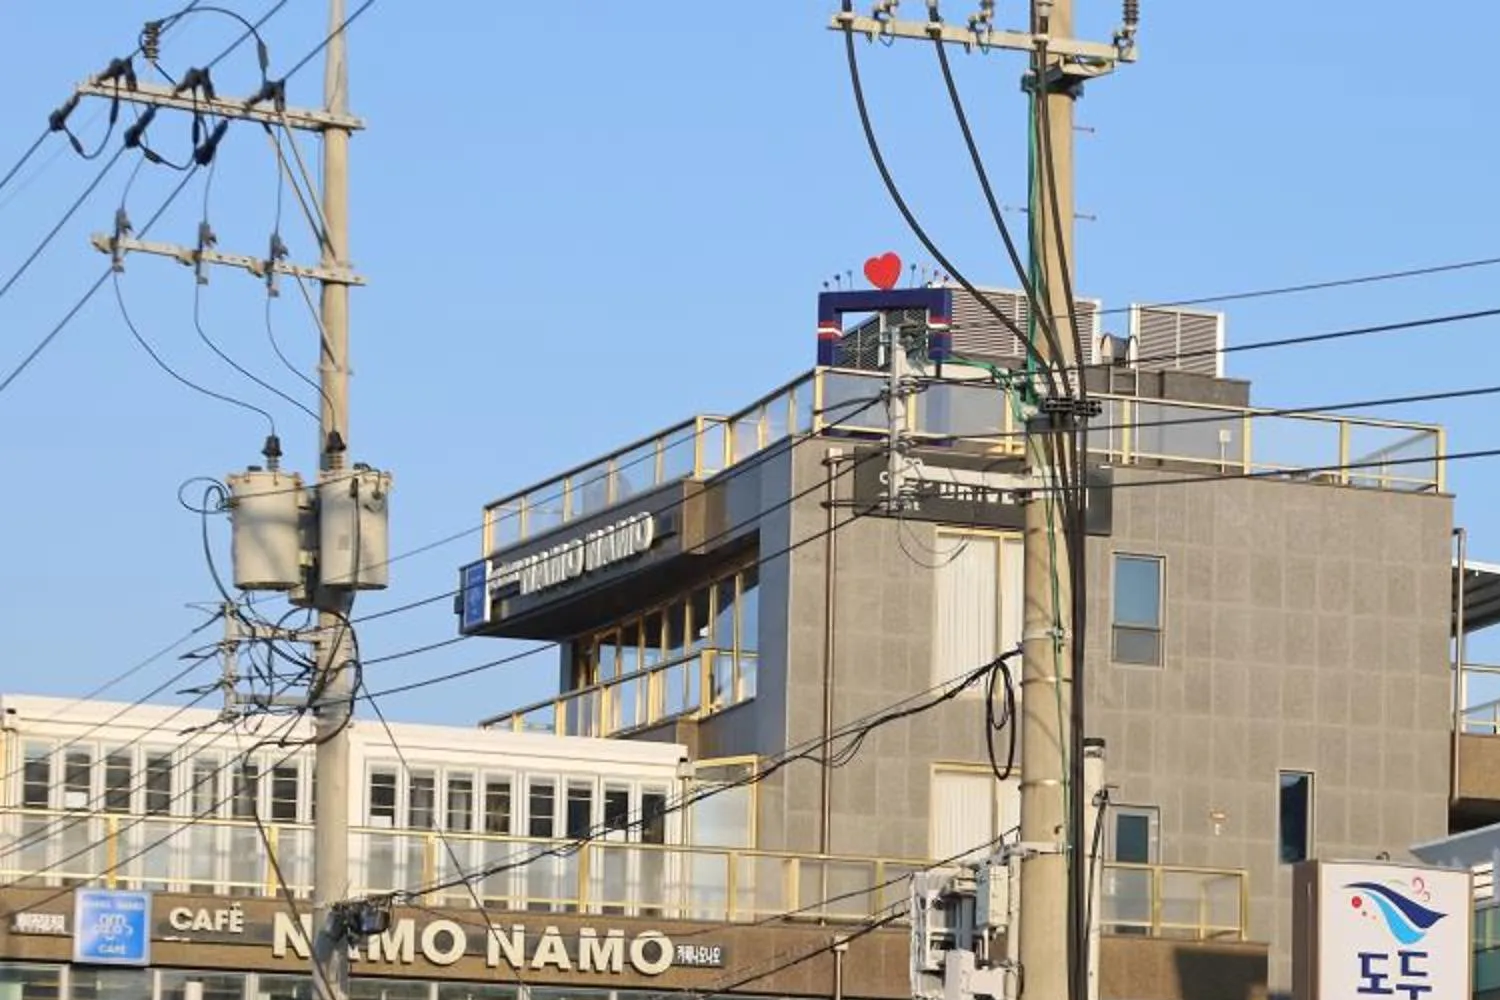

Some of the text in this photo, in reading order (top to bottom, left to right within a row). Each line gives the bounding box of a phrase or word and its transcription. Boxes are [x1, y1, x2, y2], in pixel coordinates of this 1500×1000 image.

[169, 902, 244, 933] CAFÉ
[272, 911, 673, 975] NMO NAMO
[1357, 950, 1434, 1000] 도두
